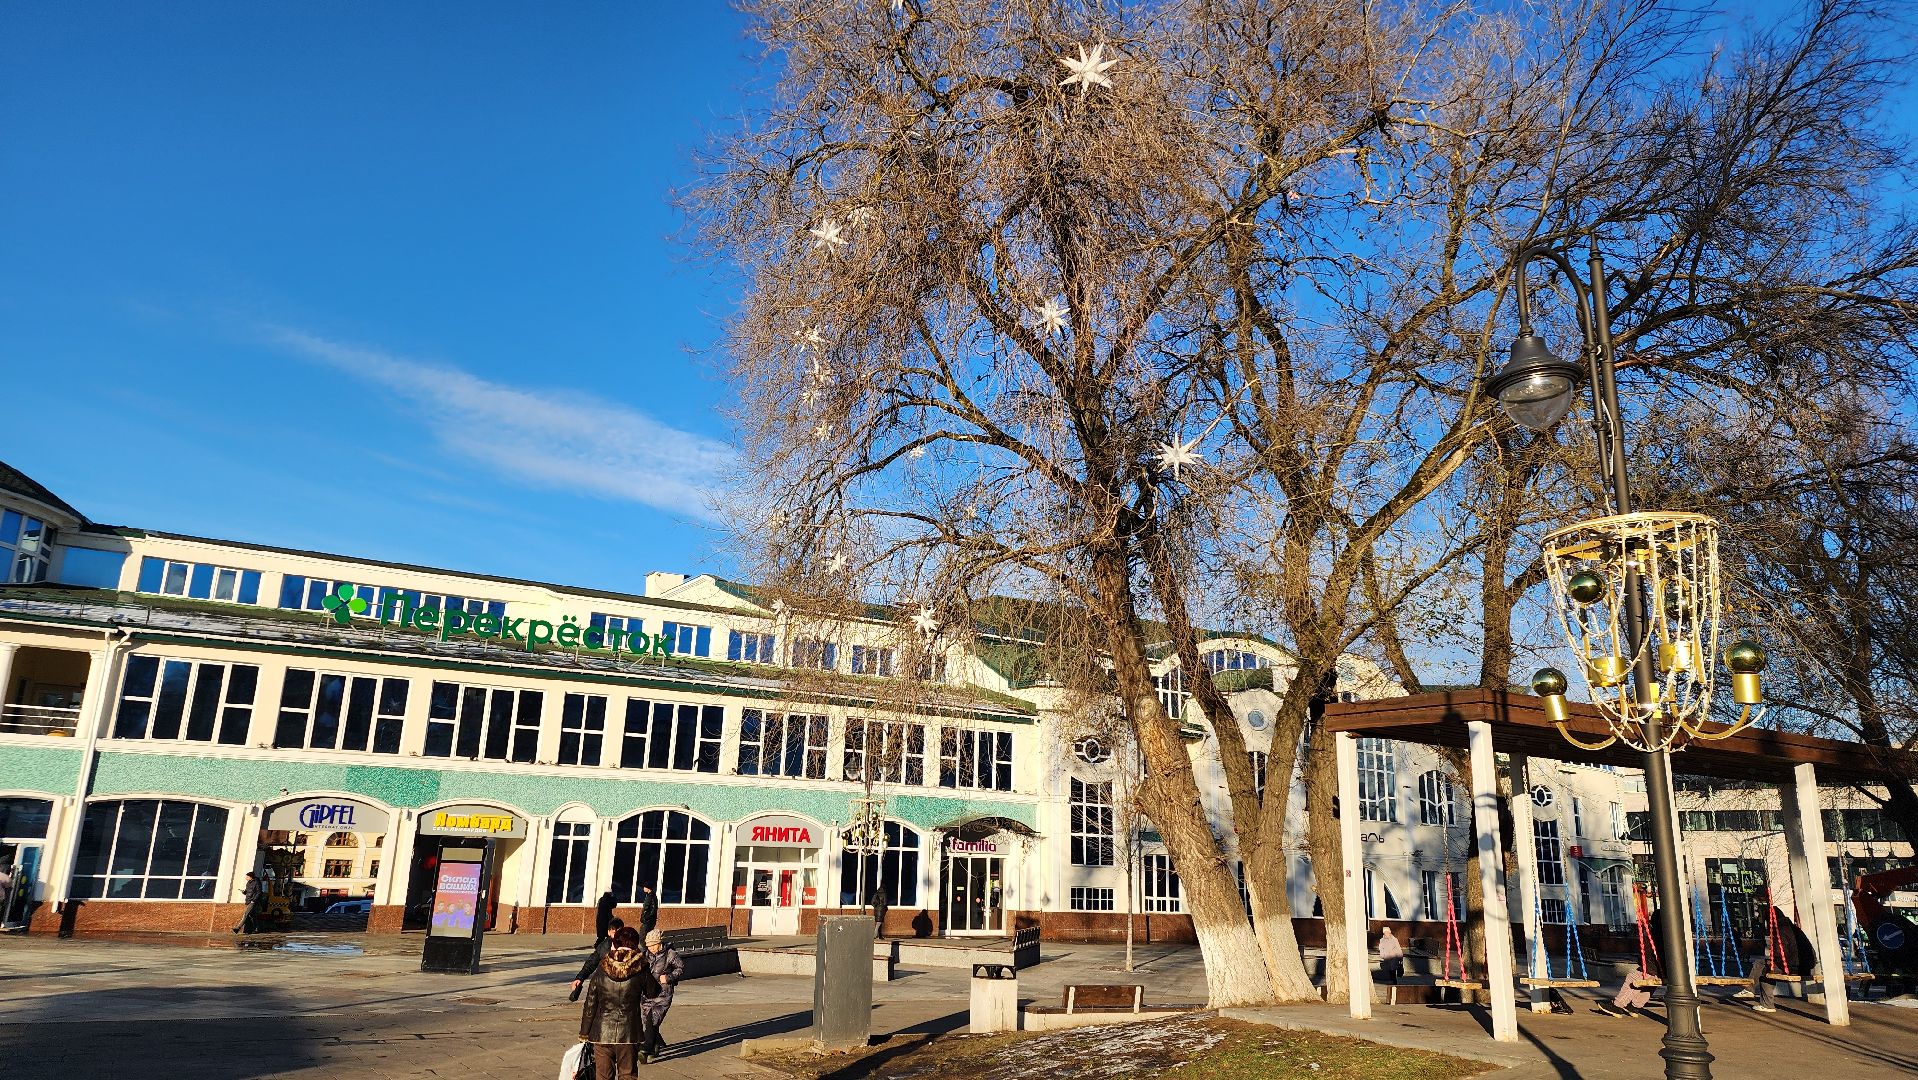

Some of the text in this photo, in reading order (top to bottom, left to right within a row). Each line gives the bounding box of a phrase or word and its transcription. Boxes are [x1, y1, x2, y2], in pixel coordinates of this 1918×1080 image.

[379, 591, 672, 659] Перекрёсток
[434, 812, 513, 833] Ломбард
[751, 826, 811, 843] ЯНИТА
[441, 874, 477, 885] Склад
